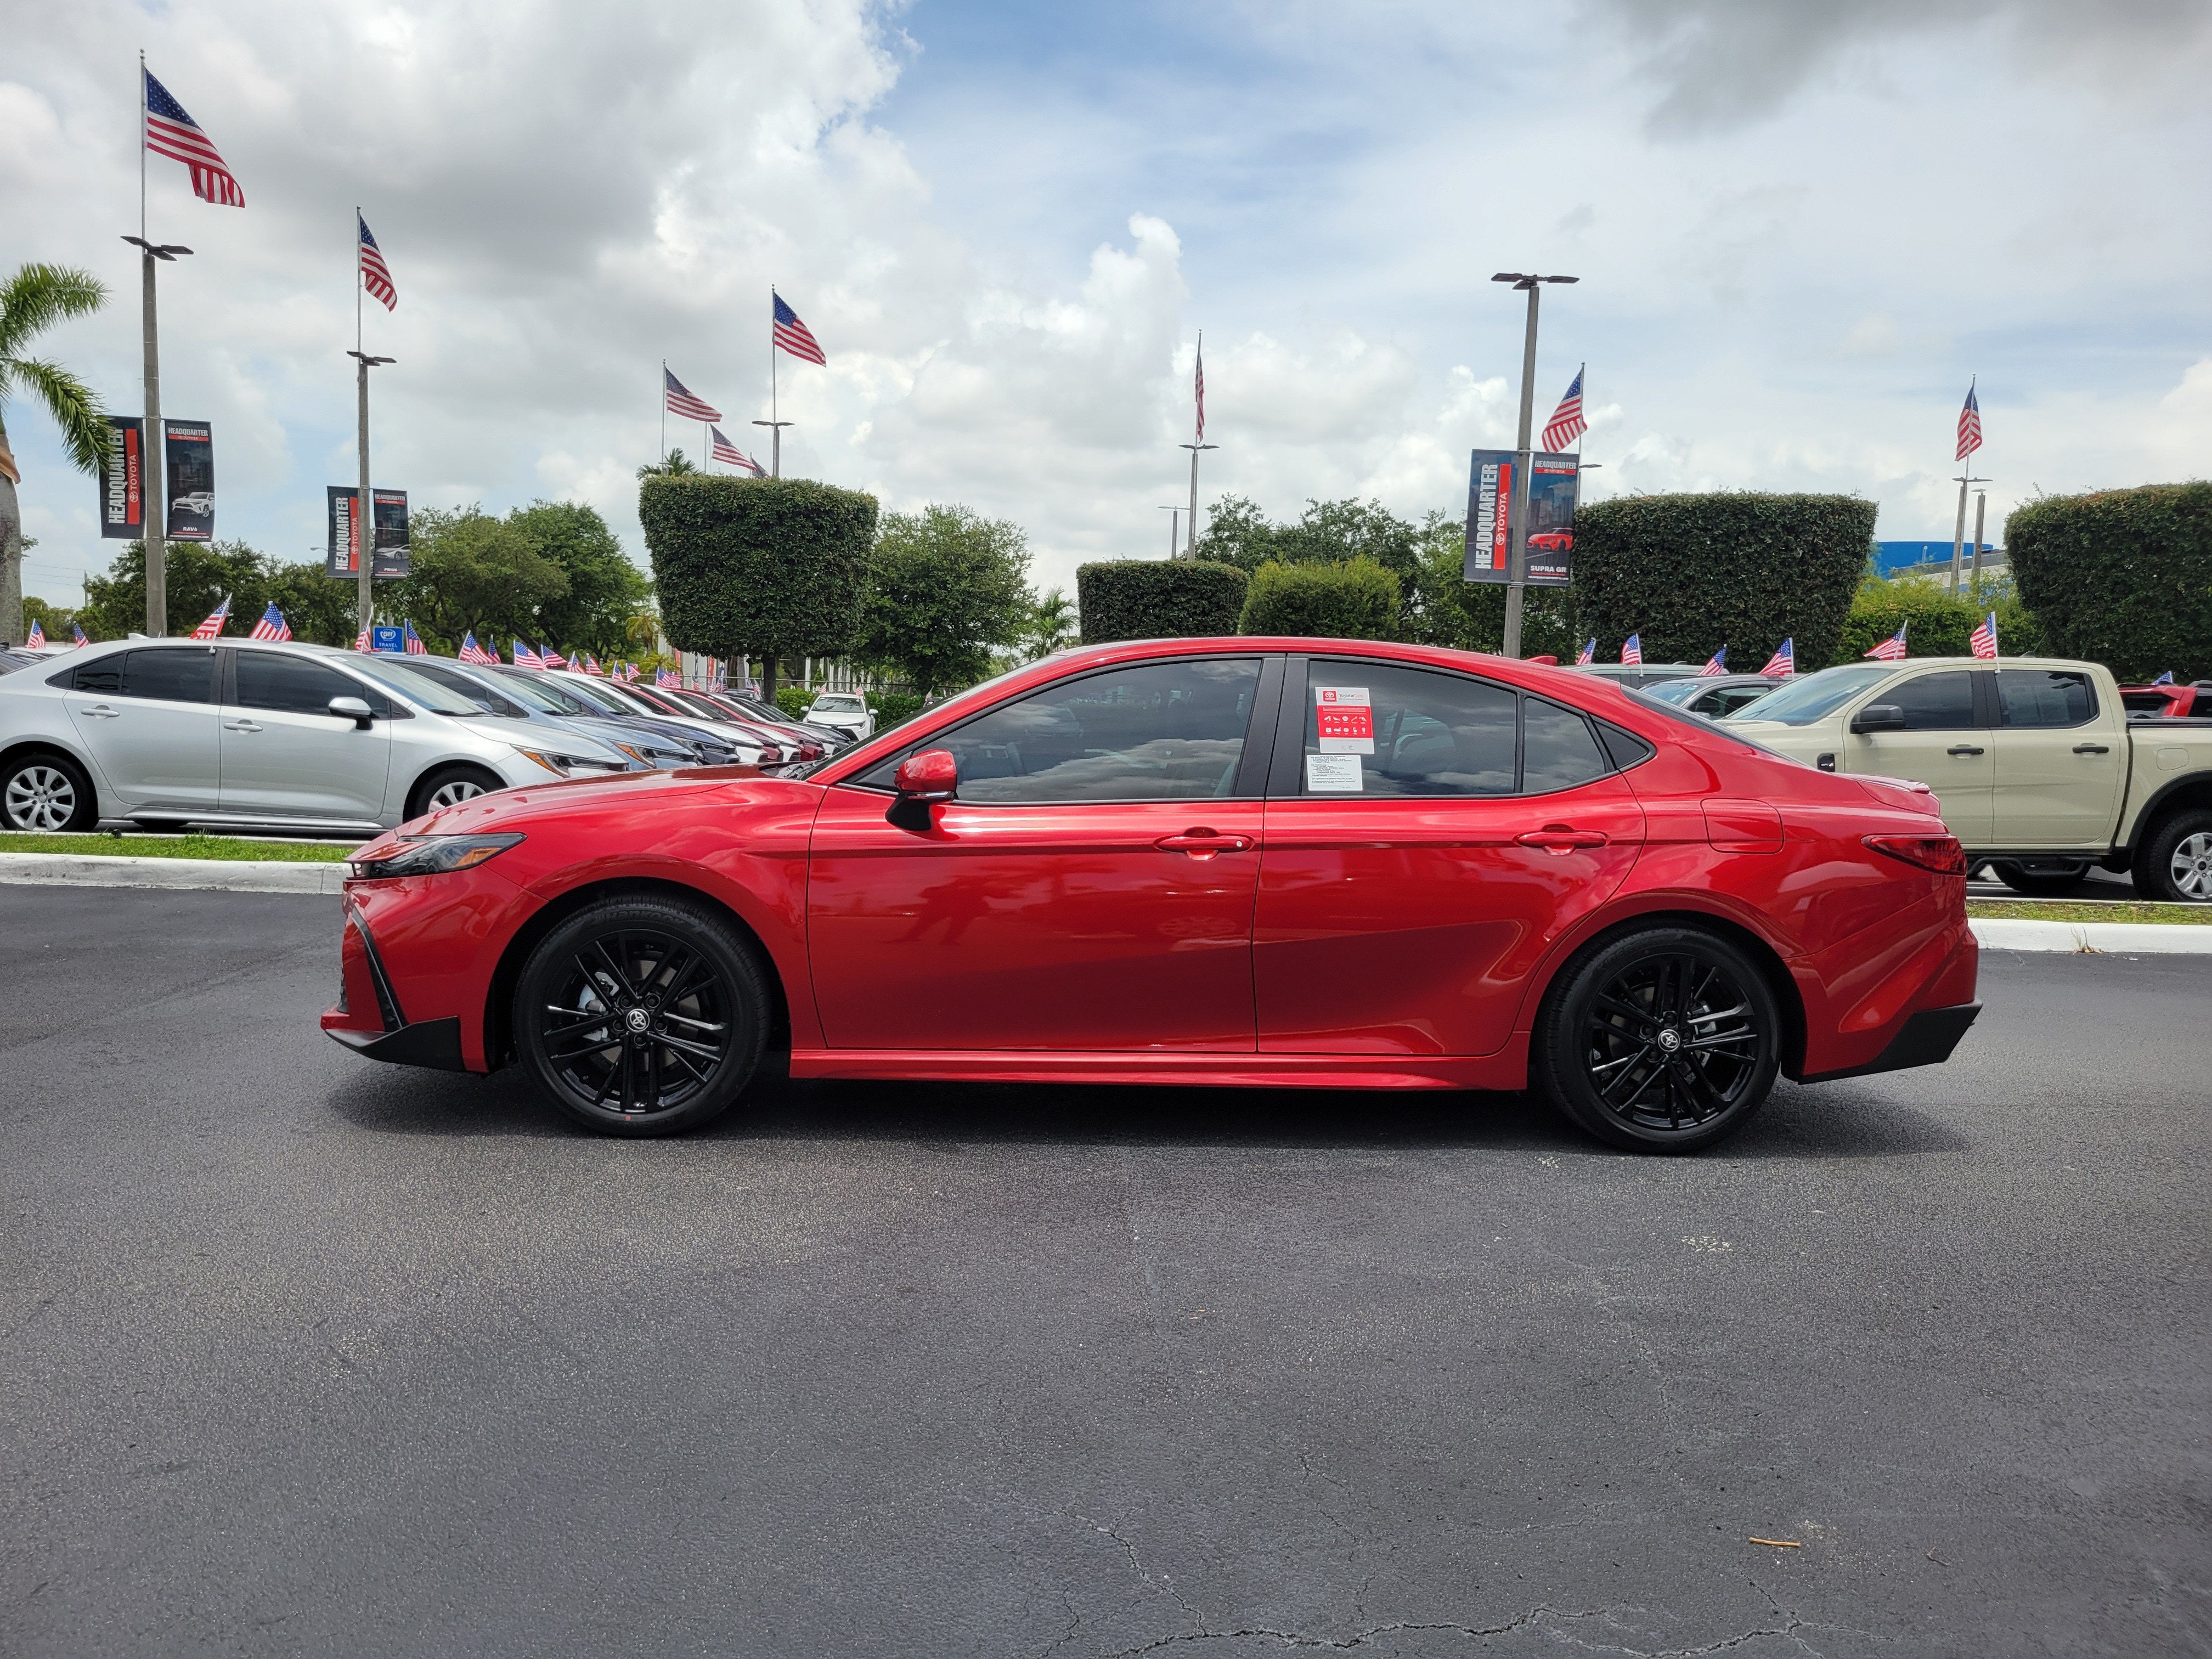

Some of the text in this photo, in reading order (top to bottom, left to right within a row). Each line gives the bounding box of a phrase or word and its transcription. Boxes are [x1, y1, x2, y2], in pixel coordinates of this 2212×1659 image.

[168, 427, 208, 436] HEADQUARTER
[108, 429, 128, 524] HEADQUARTER
[129, 454, 137, 490] TOYOTA
[1535, 460, 1577, 469] HEADQUARTER
[1475, 464, 1498, 569] HEADQUARTER
[1498, 493, 1508, 532] TOYOTA
[335, 497, 351, 570] HEADQUARTER
